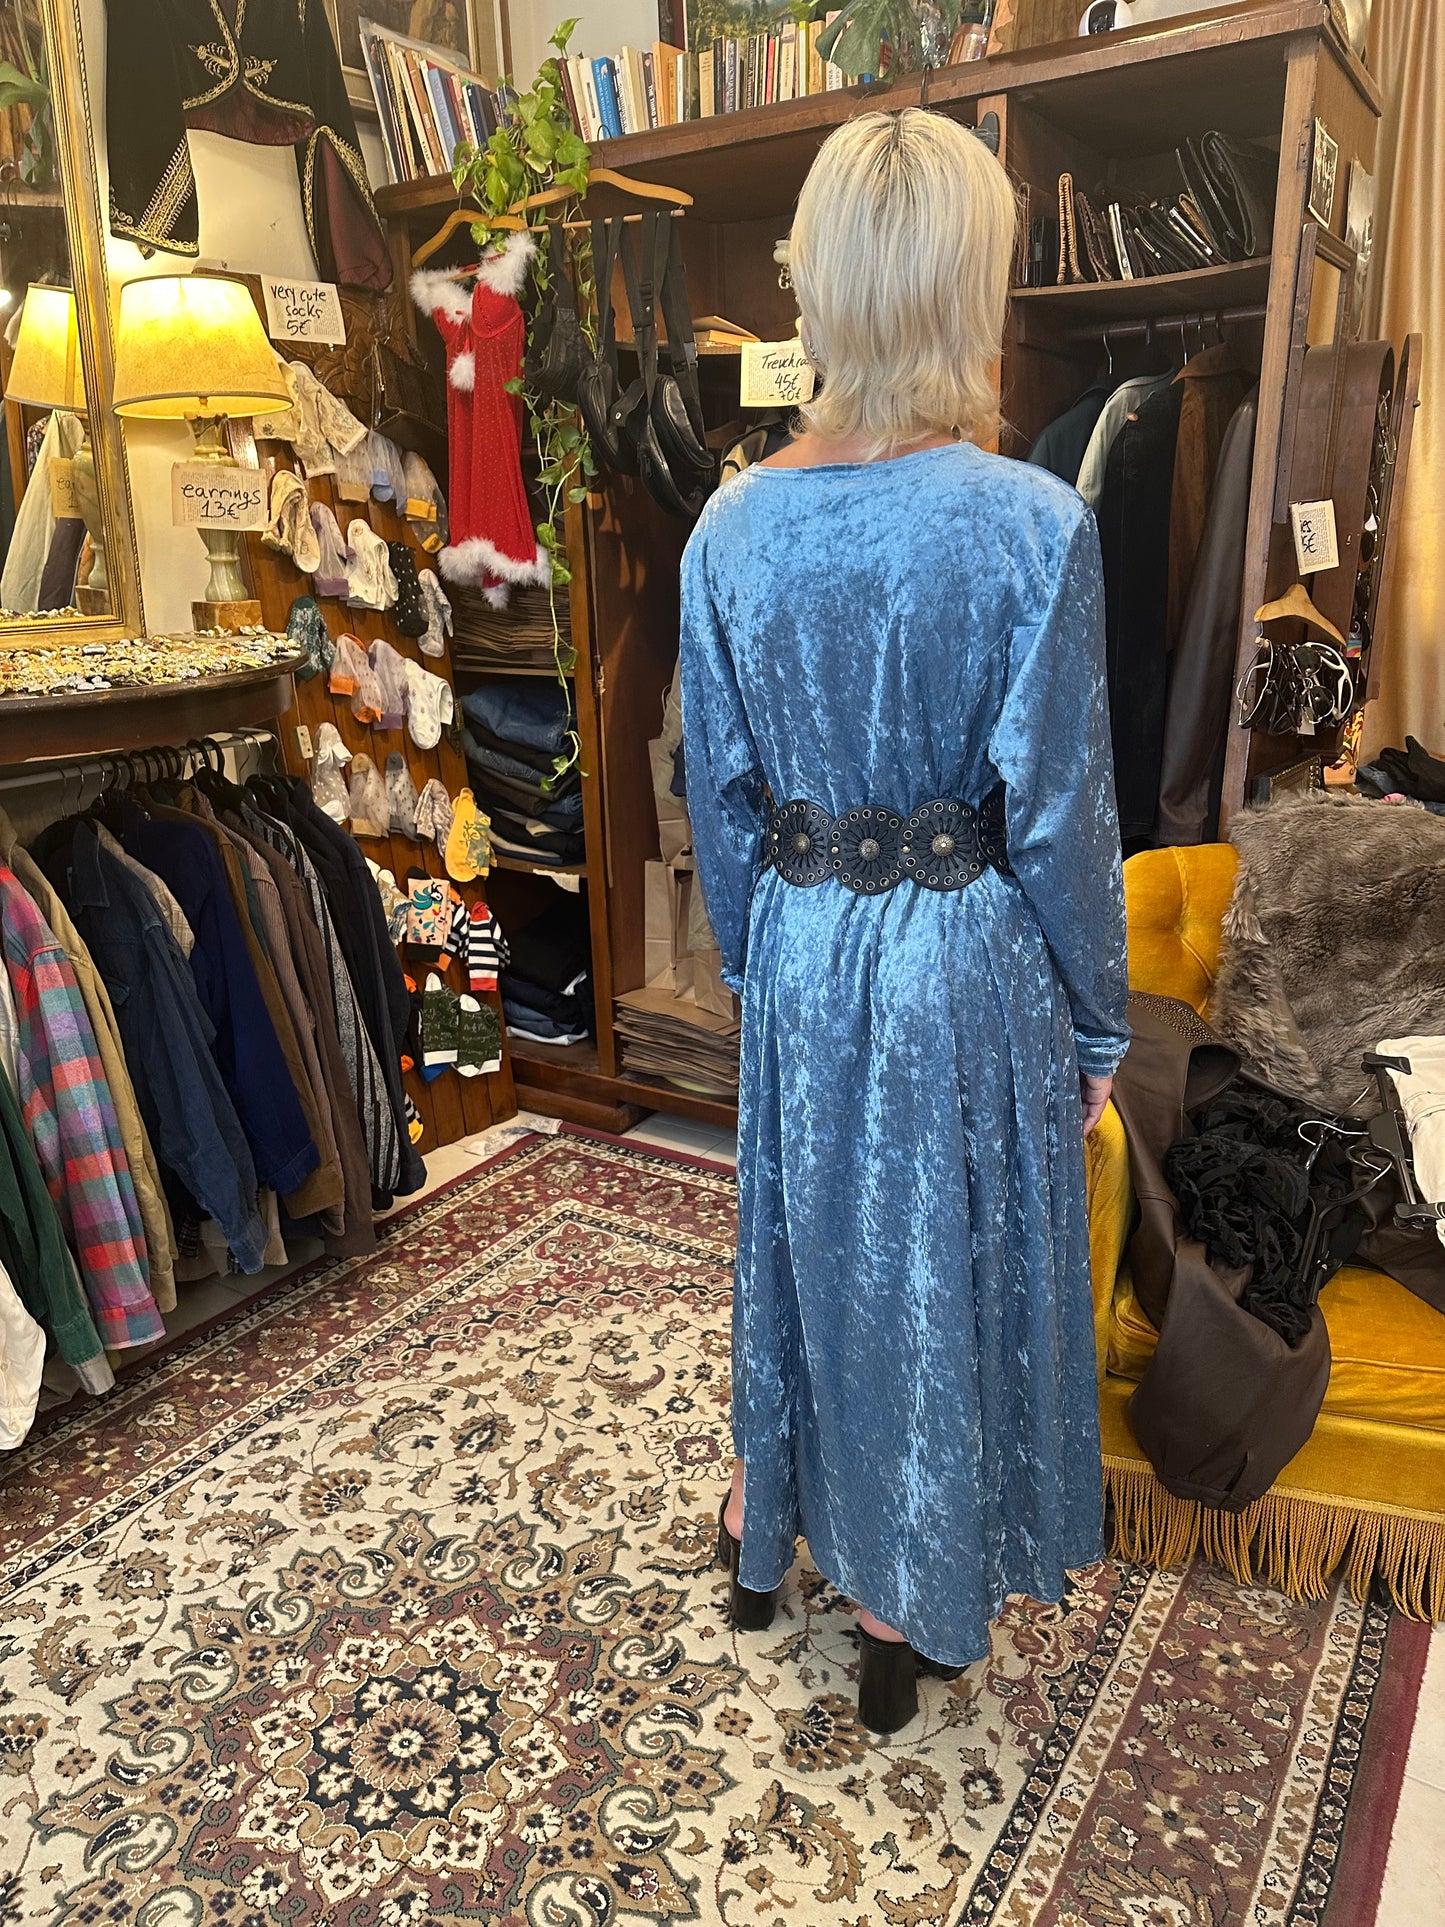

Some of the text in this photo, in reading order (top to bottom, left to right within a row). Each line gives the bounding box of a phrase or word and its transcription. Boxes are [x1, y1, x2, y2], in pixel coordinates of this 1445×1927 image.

[270, 285, 326, 306] very cute
[285, 301, 323, 319] socks
[286, 319, 312, 336] 5€
[775, 373, 800, 391] 45€
[779, 388, 802, 401] 70€
[181, 484, 261, 510] earrings
[200, 500, 239, 520] 13€
